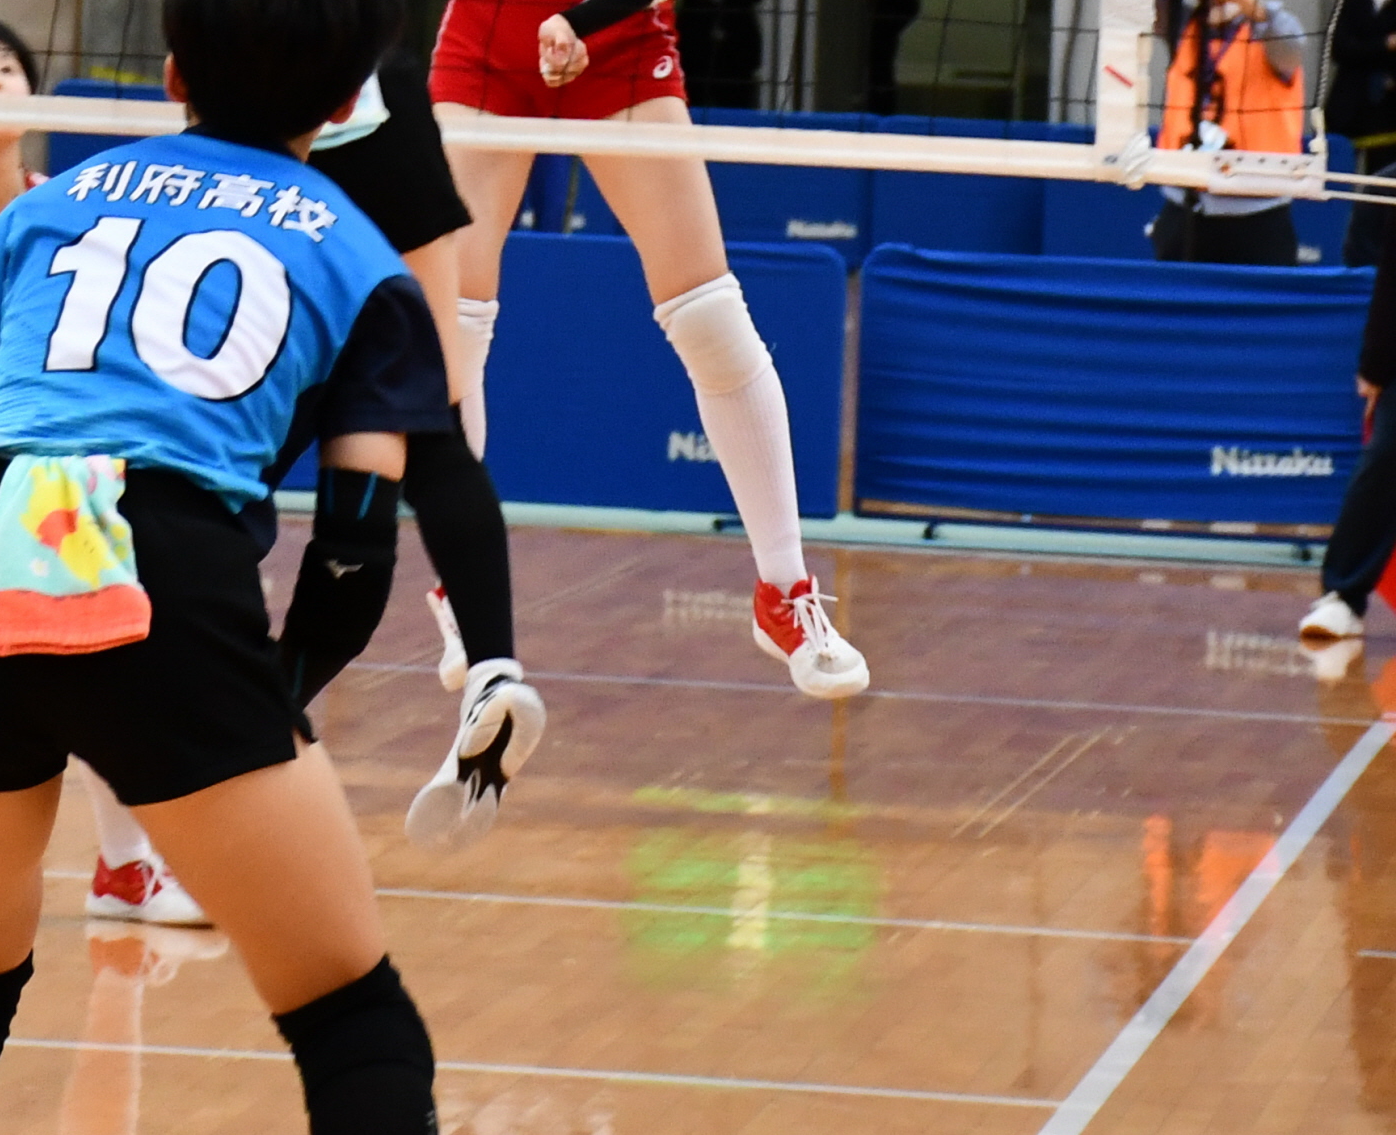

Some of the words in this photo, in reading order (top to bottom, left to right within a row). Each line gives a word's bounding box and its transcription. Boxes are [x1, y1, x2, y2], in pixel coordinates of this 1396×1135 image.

[66, 160, 339, 243] 利府高校
[42, 215, 292, 402] 10
[1211, 446, 1334, 476] Nittaku
